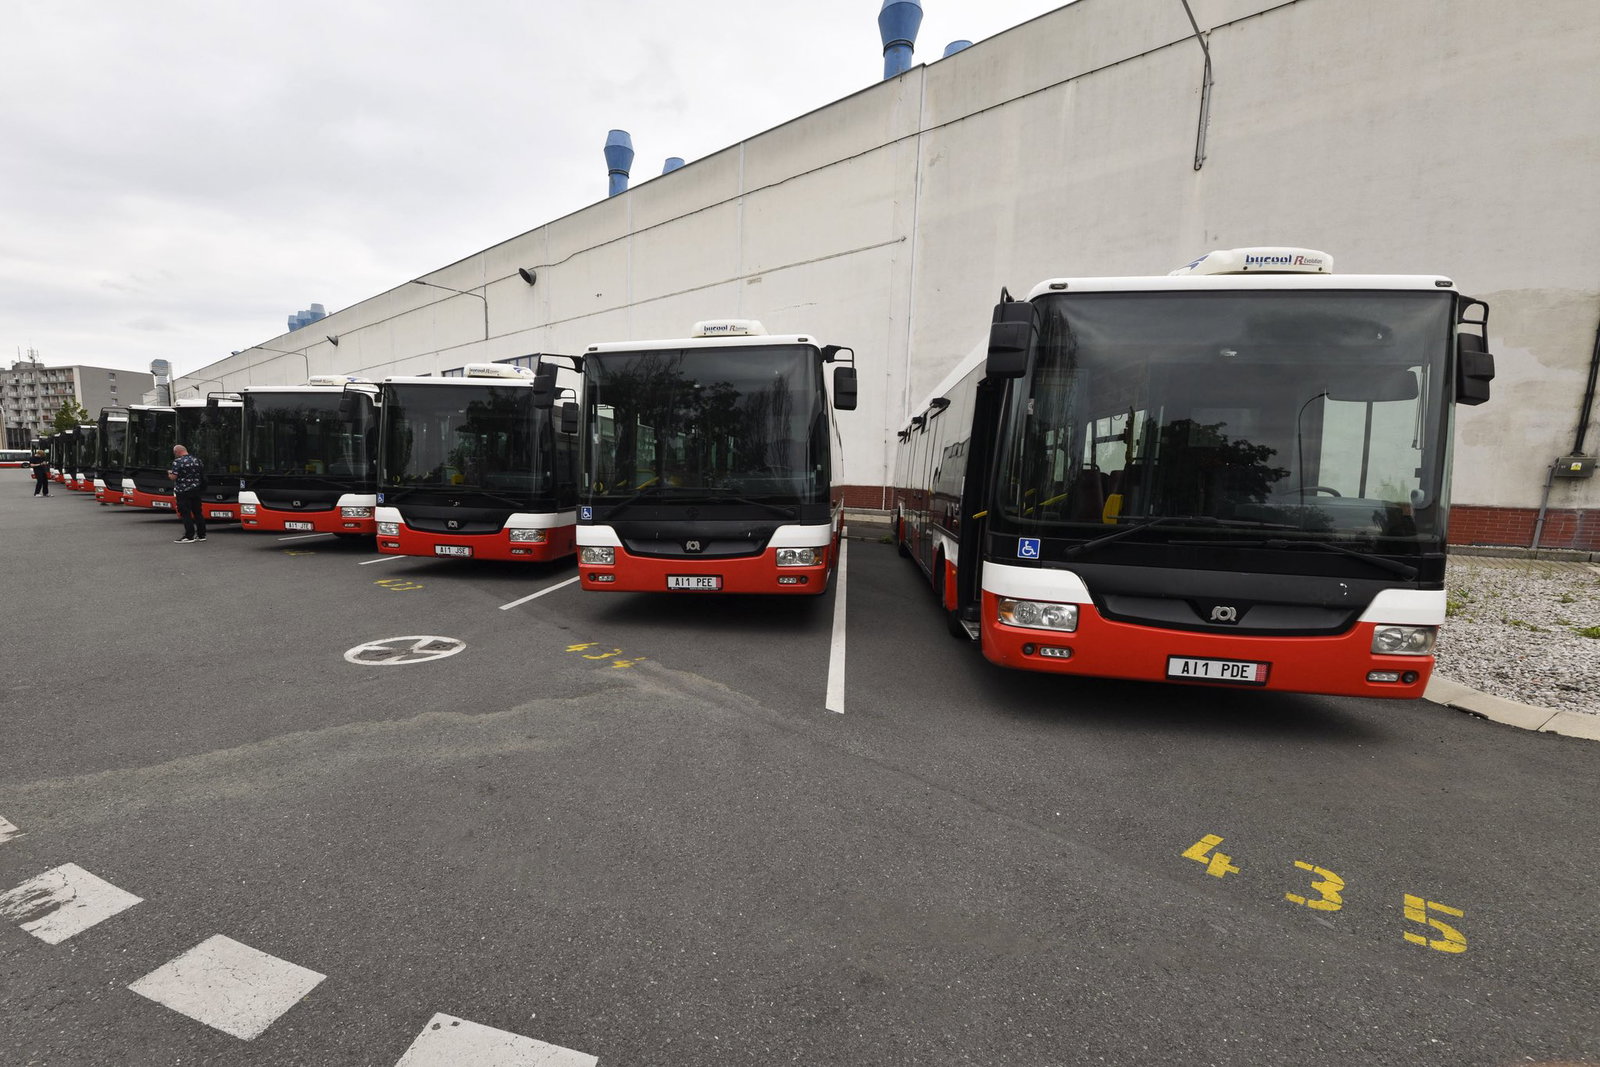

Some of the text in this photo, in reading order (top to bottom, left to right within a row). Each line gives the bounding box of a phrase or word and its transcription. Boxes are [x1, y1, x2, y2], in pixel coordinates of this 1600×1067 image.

[1245, 254, 1292, 267] bycool
[697, 578, 713, 586] PEE
[1221, 664, 1250, 678] PDE
